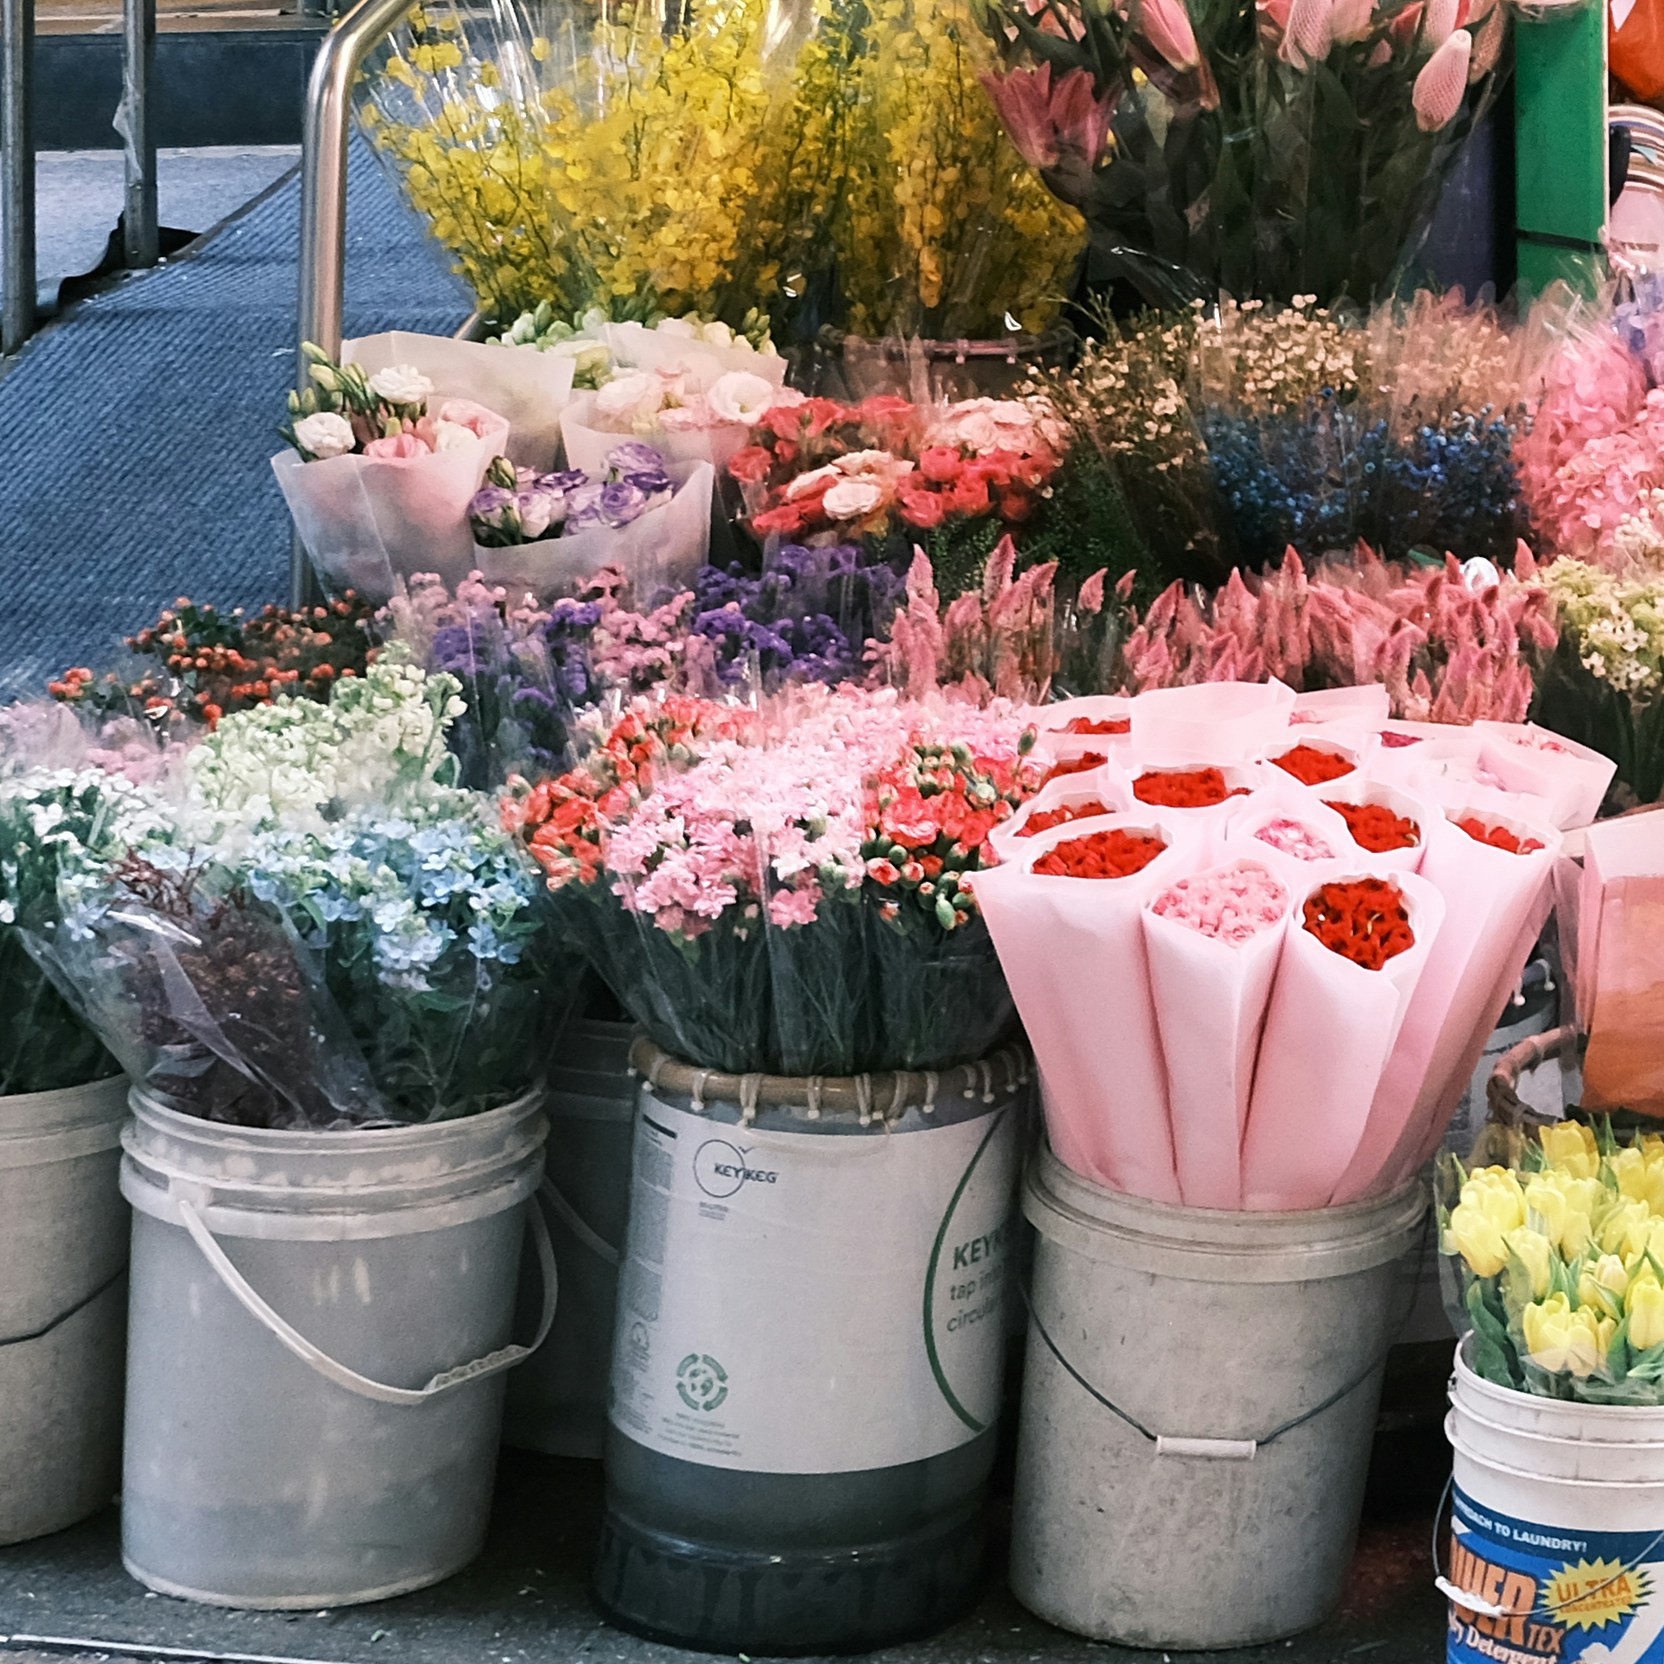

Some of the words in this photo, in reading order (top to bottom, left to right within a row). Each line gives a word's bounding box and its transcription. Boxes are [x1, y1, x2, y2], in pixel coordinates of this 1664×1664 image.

[714, 1162, 779, 1184] KEYKEG
[953, 1228, 1003, 1270] KEYK
[1494, 1522, 1511, 1537] TO
[1512, 1529, 1589, 1554] LAUNDRY!
[1557, 1575, 1633, 1603] ULTRA
[1528, 1624, 1567, 1653] TEX
